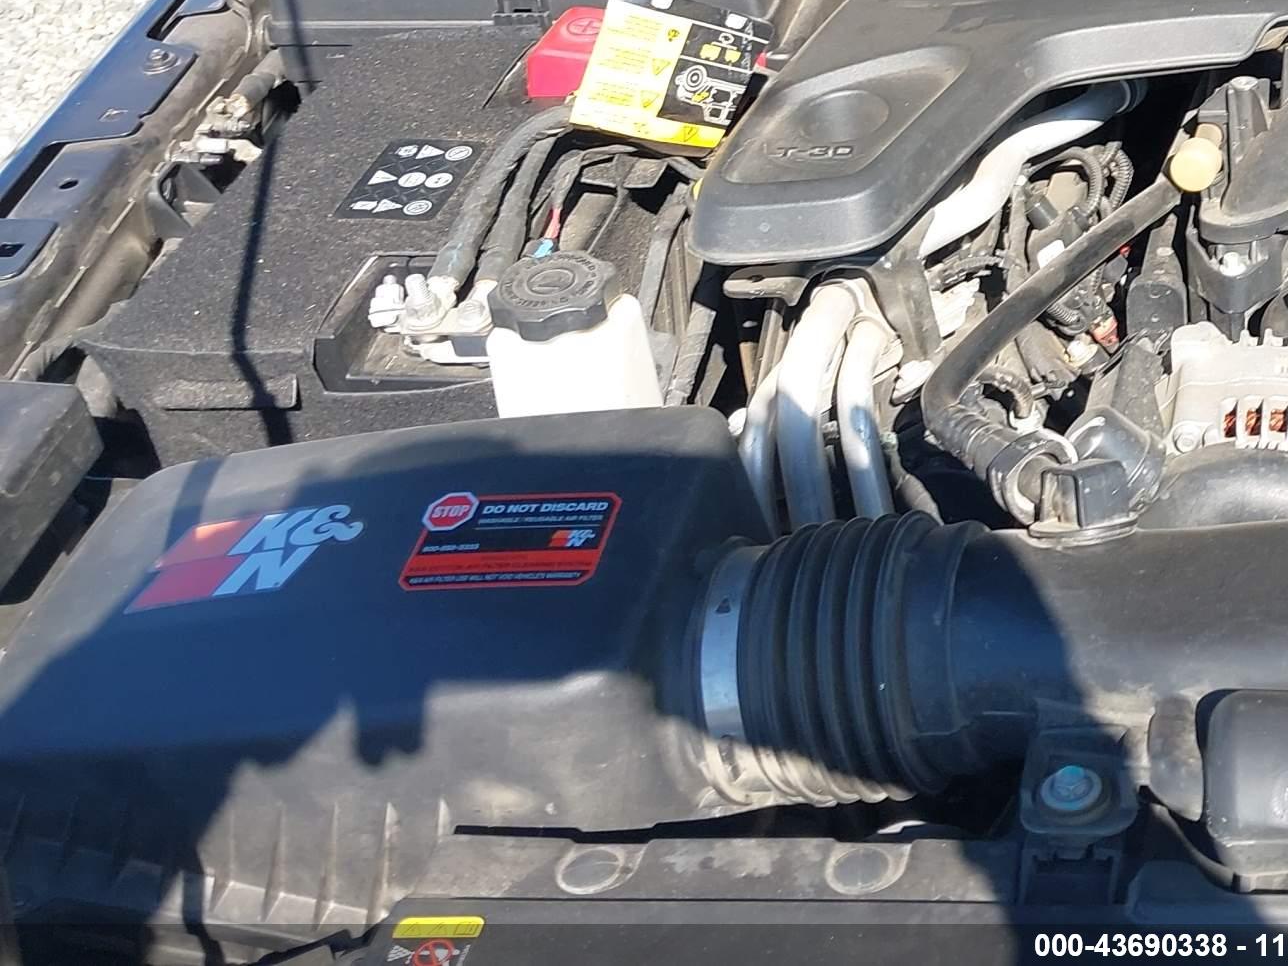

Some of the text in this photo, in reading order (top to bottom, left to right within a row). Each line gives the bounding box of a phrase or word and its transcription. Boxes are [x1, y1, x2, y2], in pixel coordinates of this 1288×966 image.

[431, 504, 470, 519] STOP
[481, 502, 609, 515] DO NOT DISCARD
